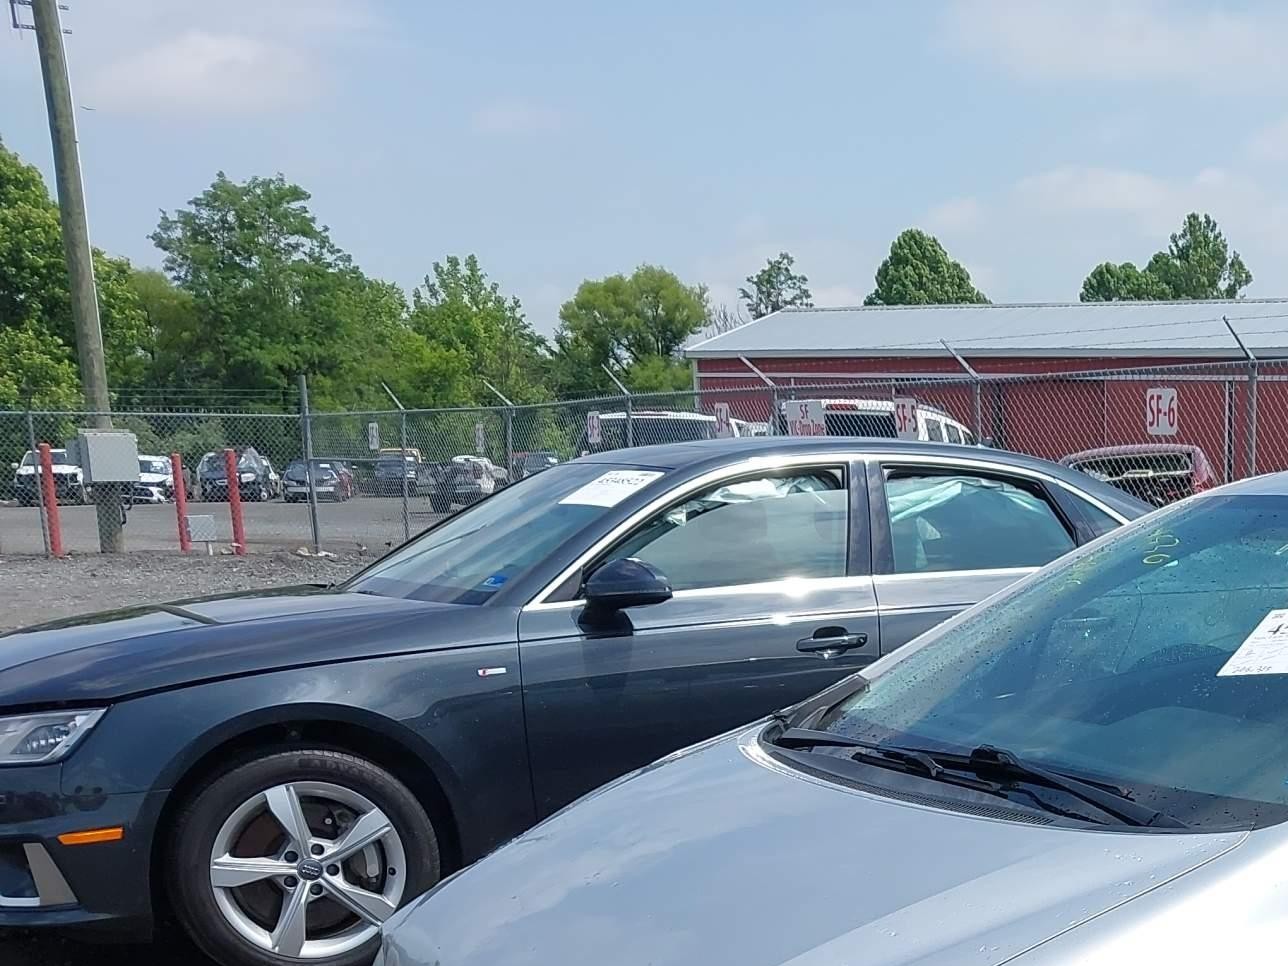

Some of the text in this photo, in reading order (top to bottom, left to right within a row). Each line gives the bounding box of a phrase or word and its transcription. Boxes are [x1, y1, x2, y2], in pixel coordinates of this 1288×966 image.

[715, 407, 730, 433] SF-4
[799, 403, 809, 420] SF
[895, 403, 918, 433] SF-5
[1148, 394, 1176, 428] SF-6
